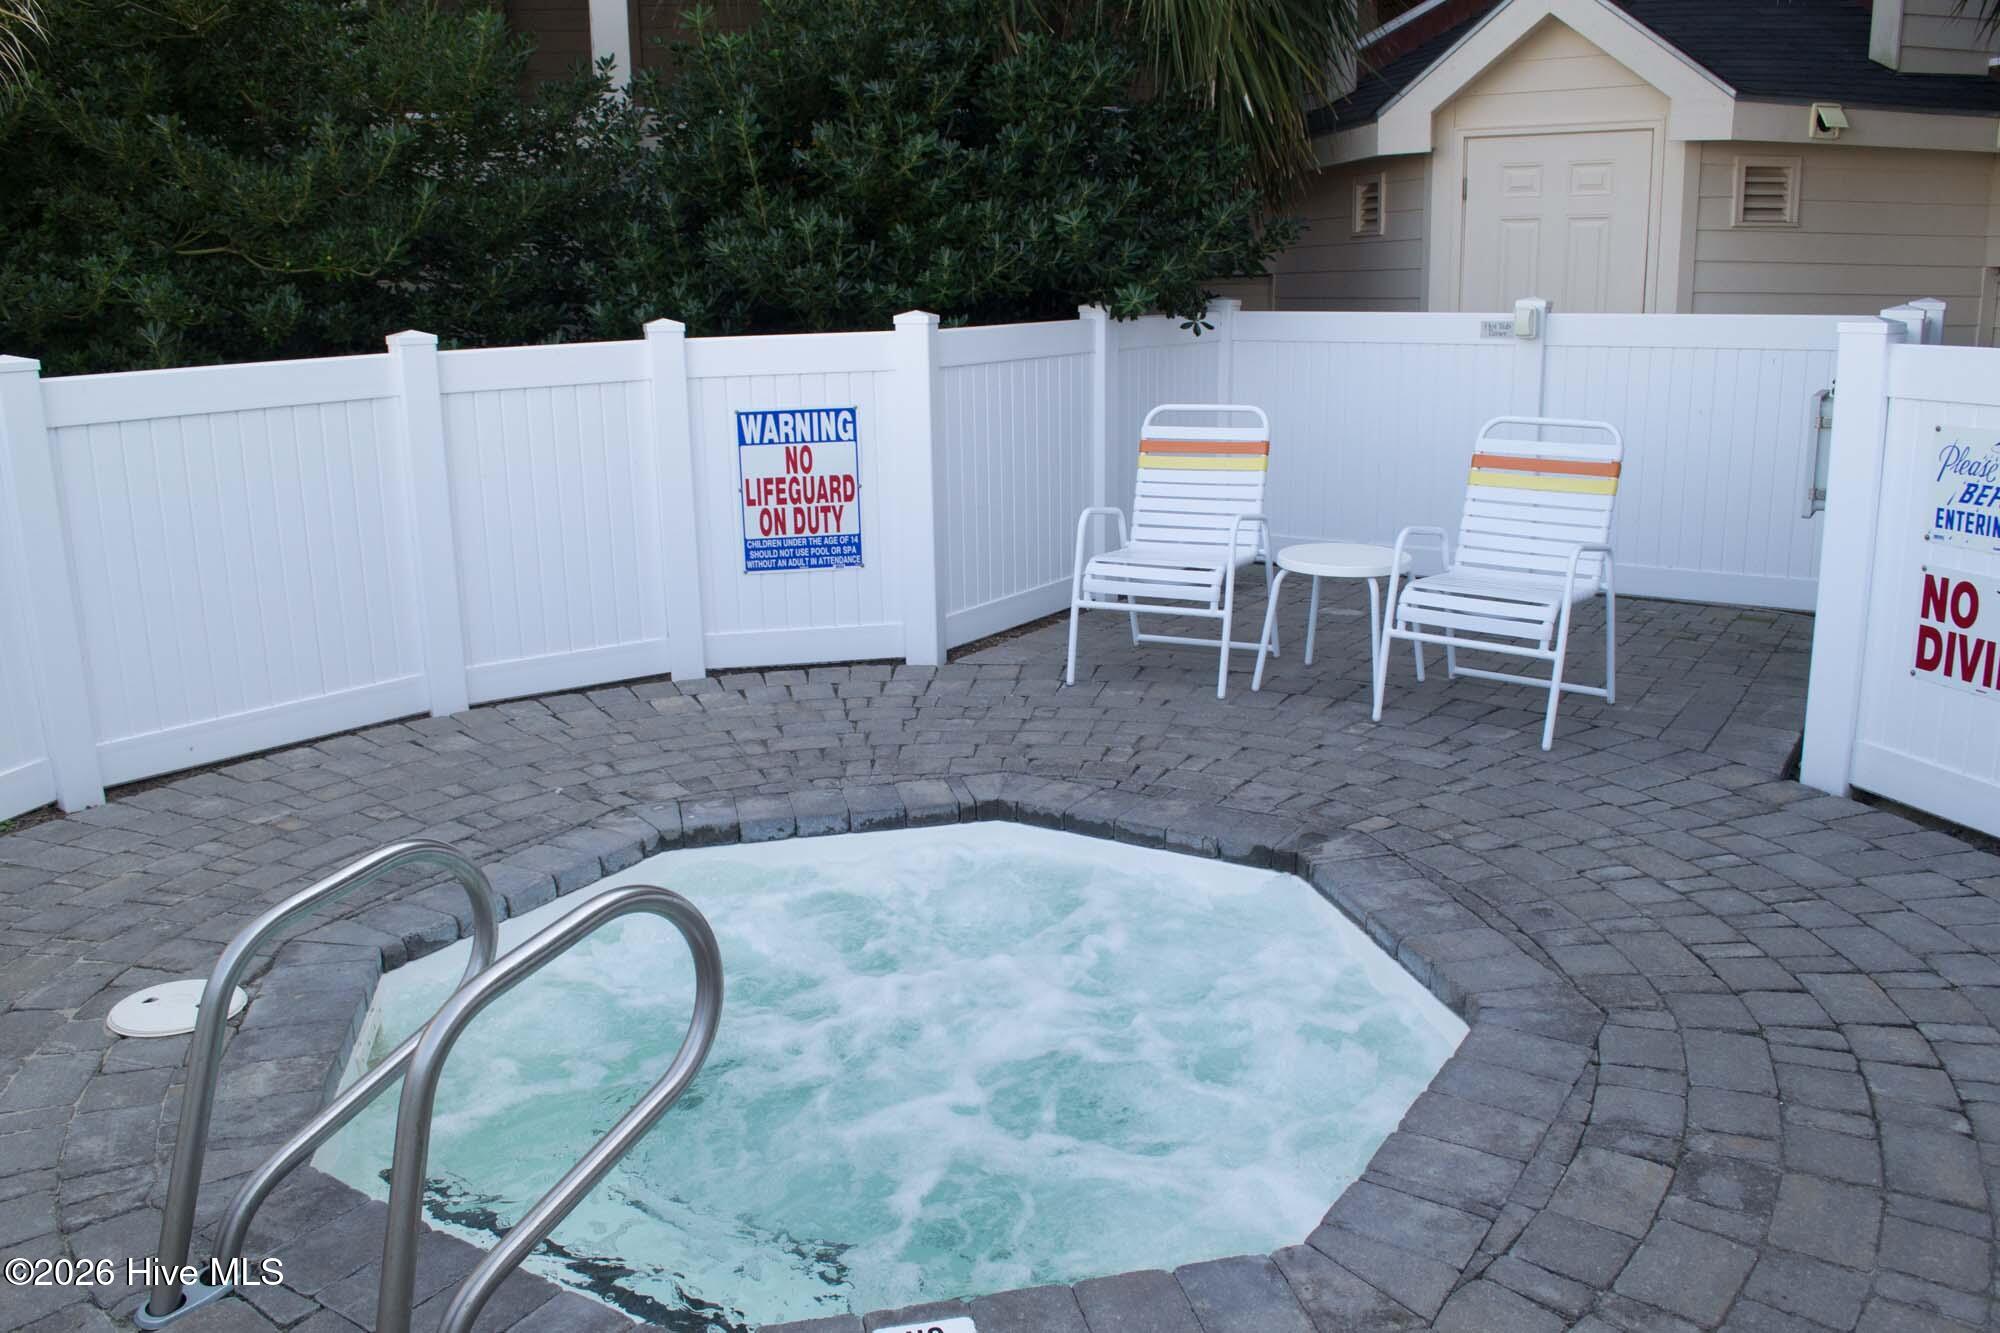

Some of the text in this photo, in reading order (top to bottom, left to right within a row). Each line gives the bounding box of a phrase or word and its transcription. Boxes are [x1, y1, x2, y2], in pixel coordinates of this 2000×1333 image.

[741, 410, 854, 444] WARNING
[785, 445, 813, 474] NO
[1937, 439, 1999, 483] Please
[745, 474, 855, 507] LIFEGUARD
[760, 505, 844, 537] ON DUTY
[746, 535, 859, 549] CHILDREN UNDER THE AGE OF 14
[750, 546, 857, 559] SHOULD NOT USE POOL OR SPA
[746, 559, 776, 569] WITHOUT
[777, 558, 787, 567] AN
[788, 558, 809, 567] ADULT
[810, 557, 817, 566] IN
[818, 555, 861, 566] ATTENDANCE
[1921, 573, 1979, 629] NO
[1915, 624, 2000, 691] DIVI
